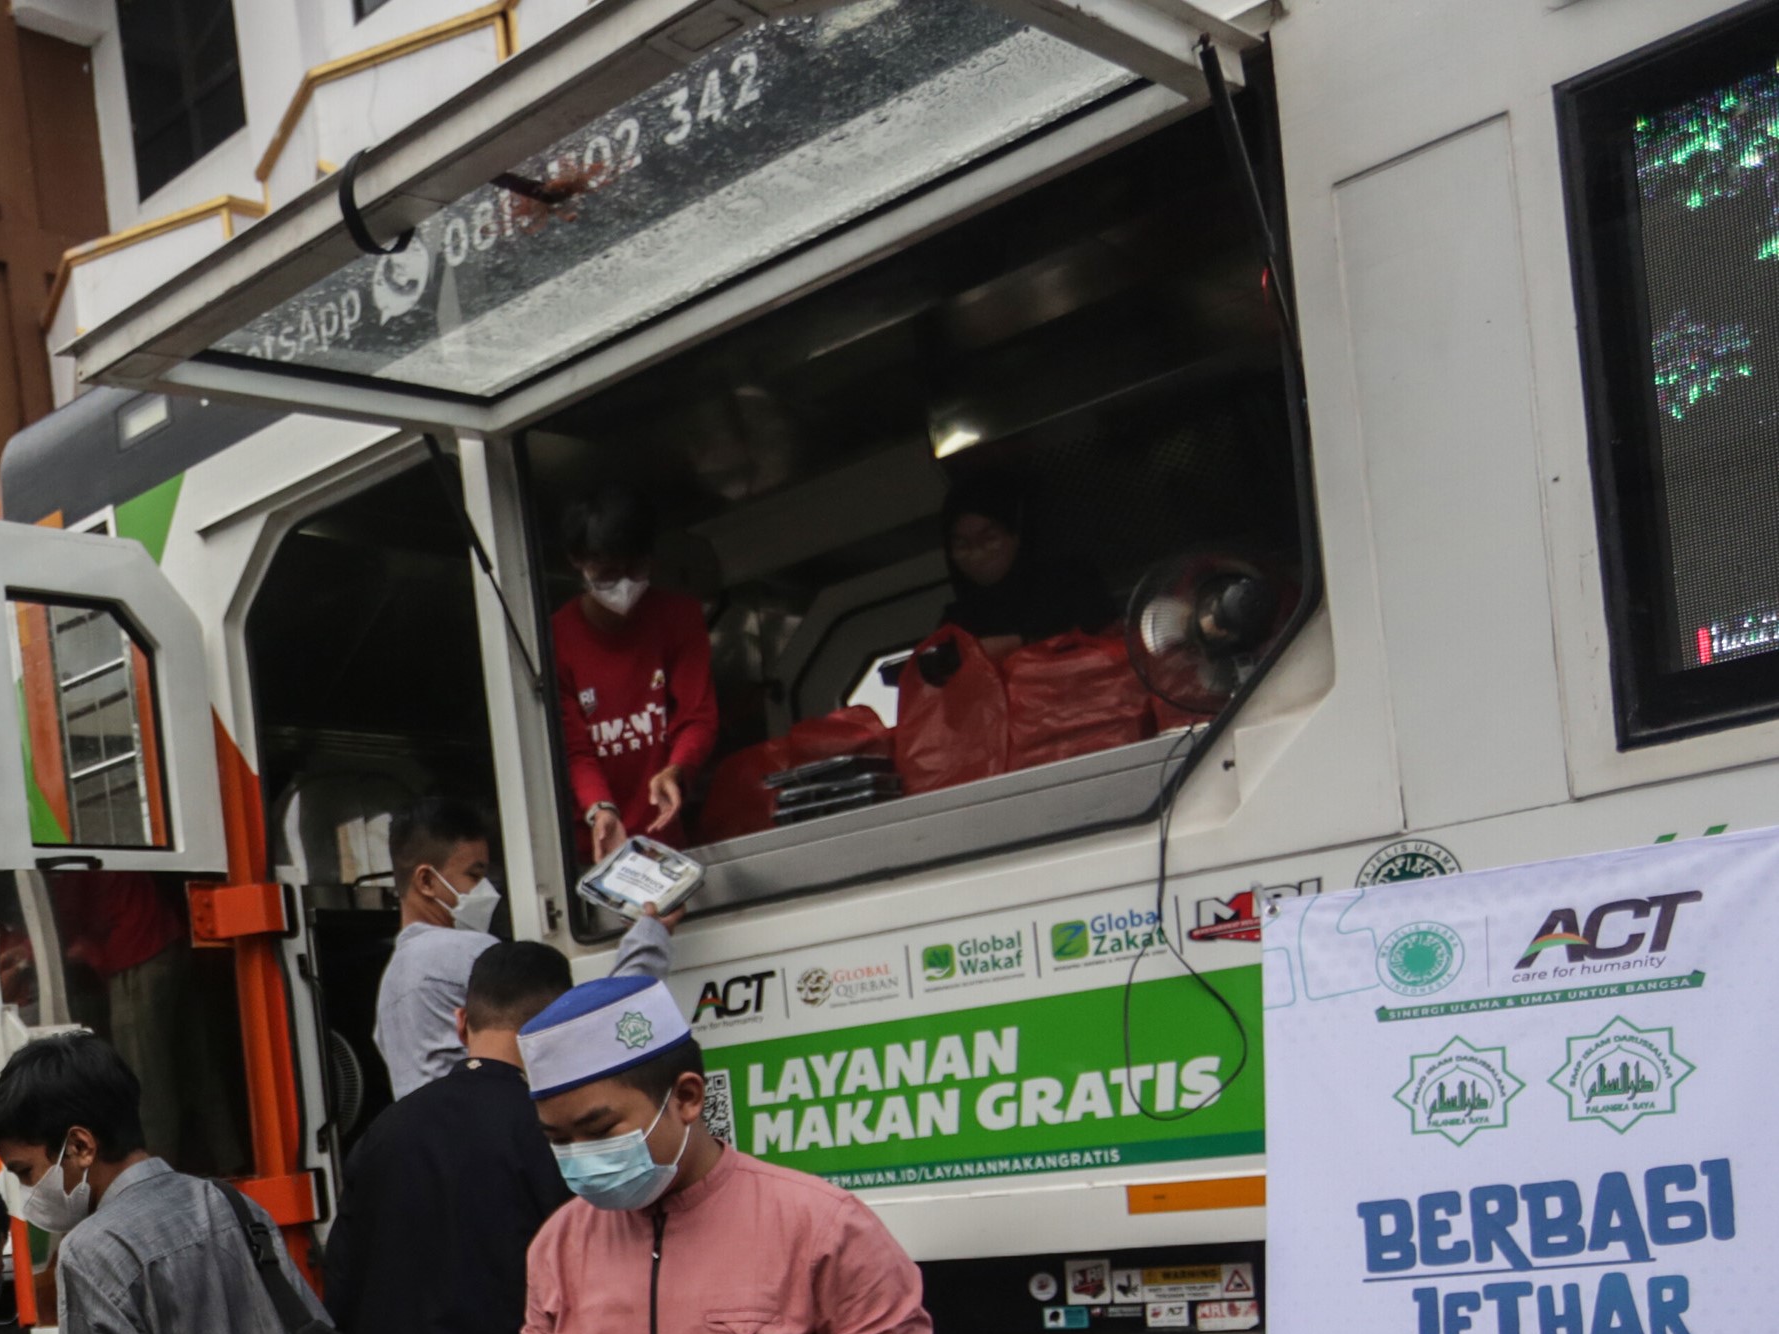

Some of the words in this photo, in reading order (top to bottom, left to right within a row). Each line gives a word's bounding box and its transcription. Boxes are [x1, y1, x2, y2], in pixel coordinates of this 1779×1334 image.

[663, 51, 761, 146] 342
[958, 930, 1022, 957] Global
[1093, 926, 1167, 957] Zakat
[1514, 890, 1703, 970] ACT
[832, 963, 892, 983] GLOBAL
[959, 950, 1024, 976] Wakaf
[1512, 969, 1548, 984] care
[1552, 966, 1575, 979] for
[1578, 954, 1668, 974] humanity
[691, 969, 776, 1024] ACT
[835, 976, 899, 998] QURBAN
[1388, 1006, 1445, 1021] SINERGI
[1450, 999, 1500, 1014] ULAMA
[1505, 997, 1515, 1008] &
[1521, 992, 1561, 1006] UMAT
[1568, 985, 1619, 1000] UNTUK
[1625, 977, 1691, 994] BANGSA
[747, 1026, 1019, 1106] LAYANAN
[752, 1081, 960, 1156] MAKAN
[975, 1056, 1222, 1131] GRATIS
